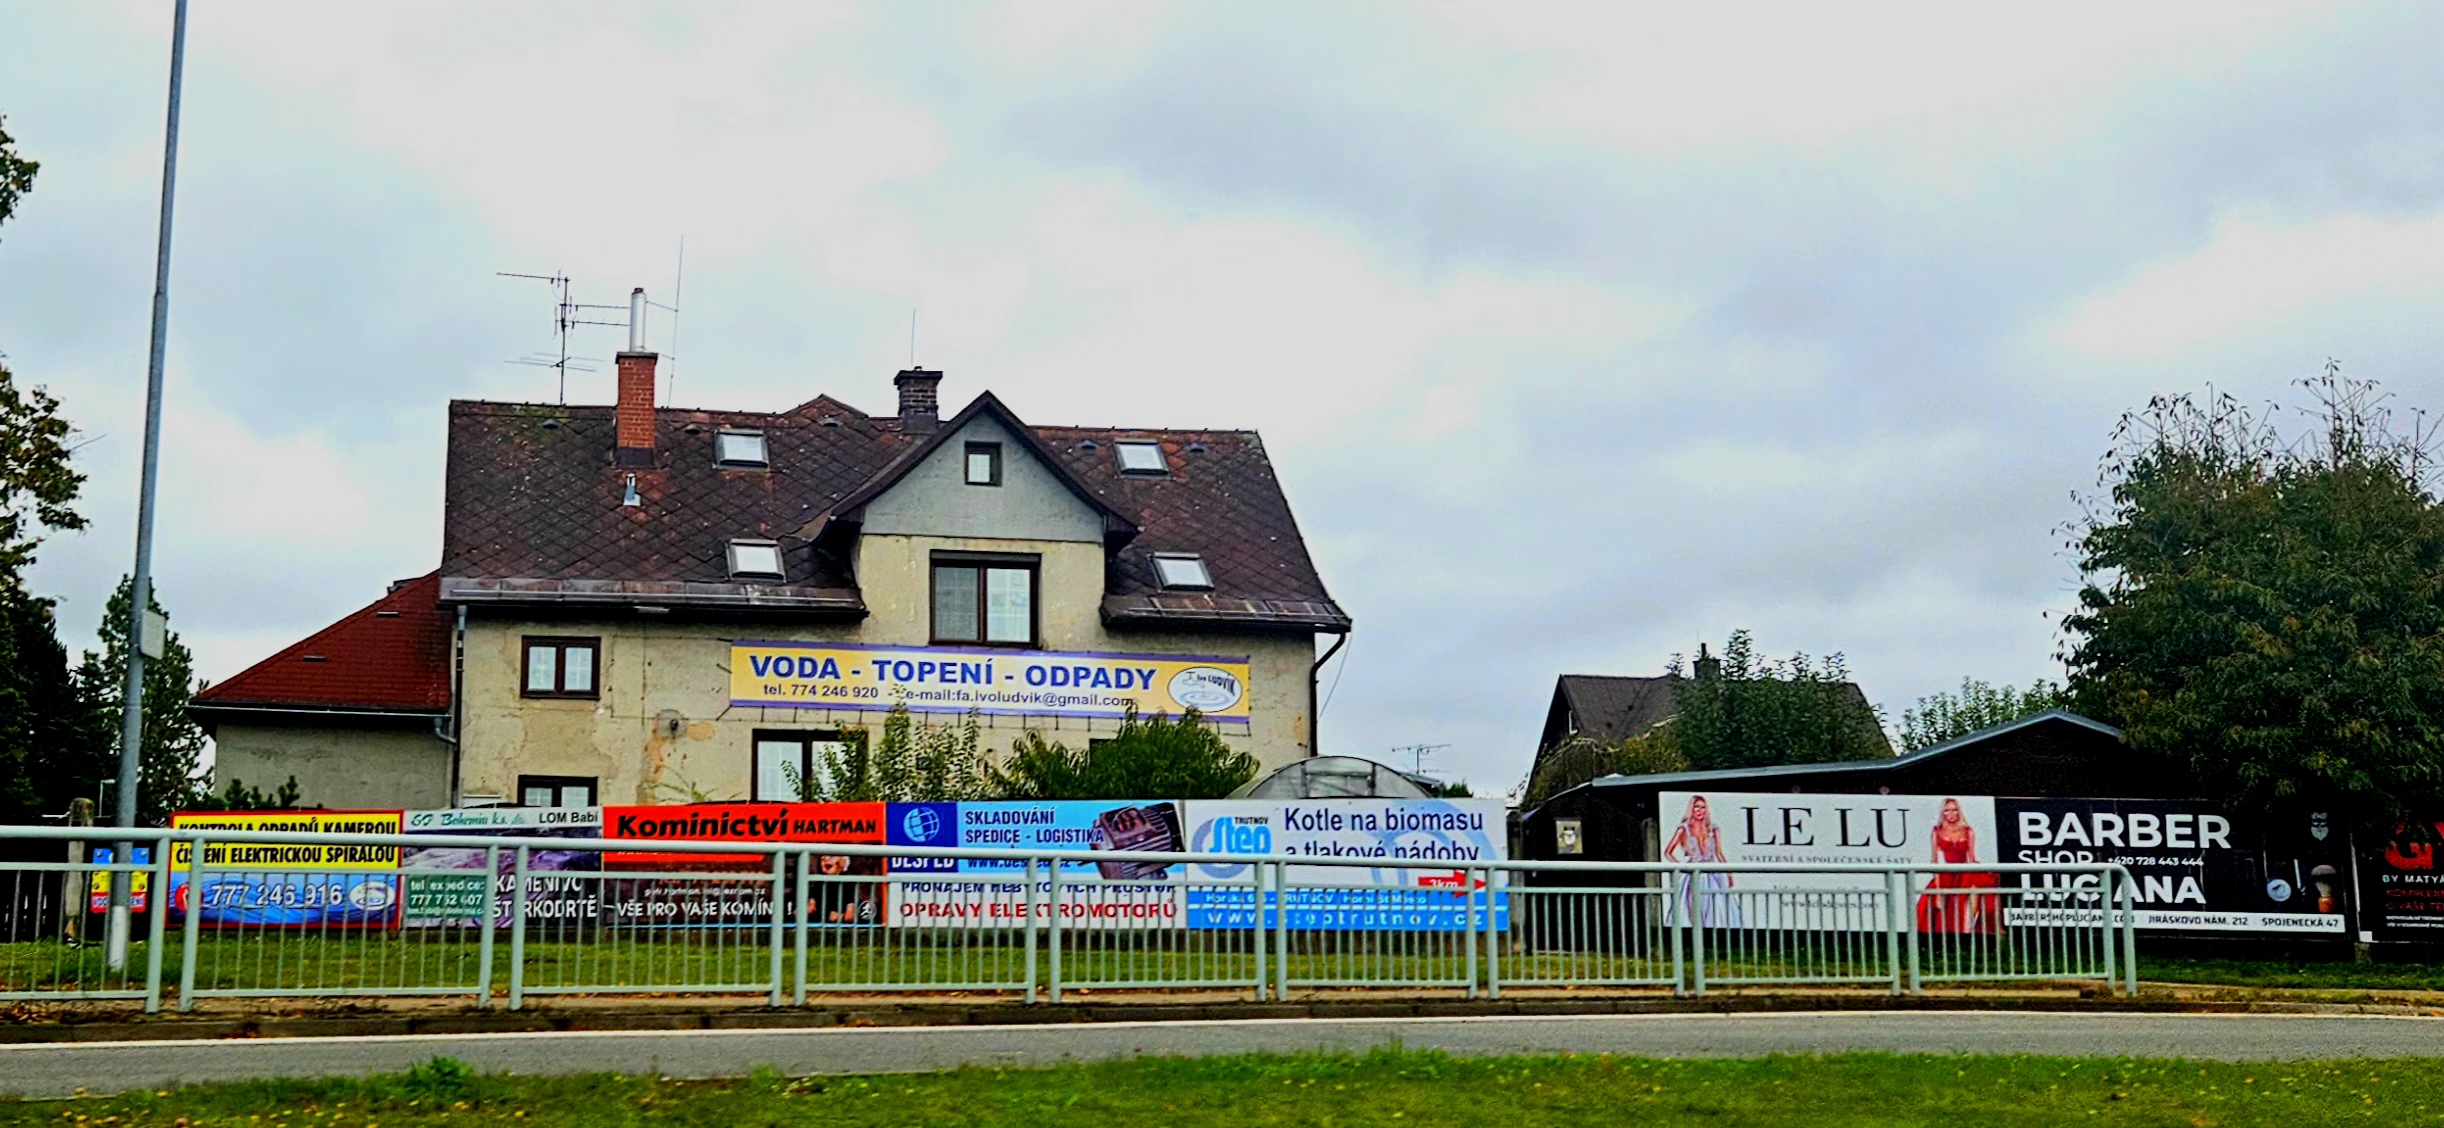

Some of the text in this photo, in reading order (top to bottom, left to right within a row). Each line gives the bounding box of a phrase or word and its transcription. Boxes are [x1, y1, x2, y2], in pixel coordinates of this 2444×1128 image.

[749, 655, 841, 680] VODA
[871, 658, 993, 685] TOPENÍ
[1025, 665, 1157, 690] ODPADY
[763, 684, 787, 695] tel.
[791, 684, 817, 696] 774
[822, 685, 849, 697] 246
[853, 686, 879, 698] 920
[539, 811, 598, 824] LOM Babí
[617, 808, 877, 837] Kominictví HARTMAN
[965, 806, 1055, 825] SKLADOVÁNÍ
[1234, 816, 1269, 825] TRUTNOV
[1285, 807, 1484, 831] Kotle na biomasu
[965, 828, 1021, 843] SPEDICE
[1036, 828, 1105, 843] LOGISTIKA
[1740, 806, 1910, 848] LE LU
[2017, 811, 2232, 849] BARBER
[230, 847, 322, 863] ELEKTRICKOU
[2018, 850, 2094, 864] SHOP
[2136, 856, 2156, 866] 728
[2158, 856, 2180, 866] 443
[2181, 856, 2205, 866] 444
[211, 884, 343, 906] 777 246 916
[2020, 873, 2207, 904] LUCANA
[410, 894, 433, 905] 777
[493, 894, 599, 919] ŠTRKODRTĚ
[616, 898, 644, 917] VŠE
[646, 902, 678, 916] PRO
[681, 899, 718, 917] VAŠE
[900, 903, 982, 918] OPRAVY
[2149, 914, 2202, 925] JIRÁSKOVO
[2232, 917, 2248, 926] 212
[2261, 916, 2325, 928] SPOJENECKÁ
[2326, 918, 2339, 928] 47
